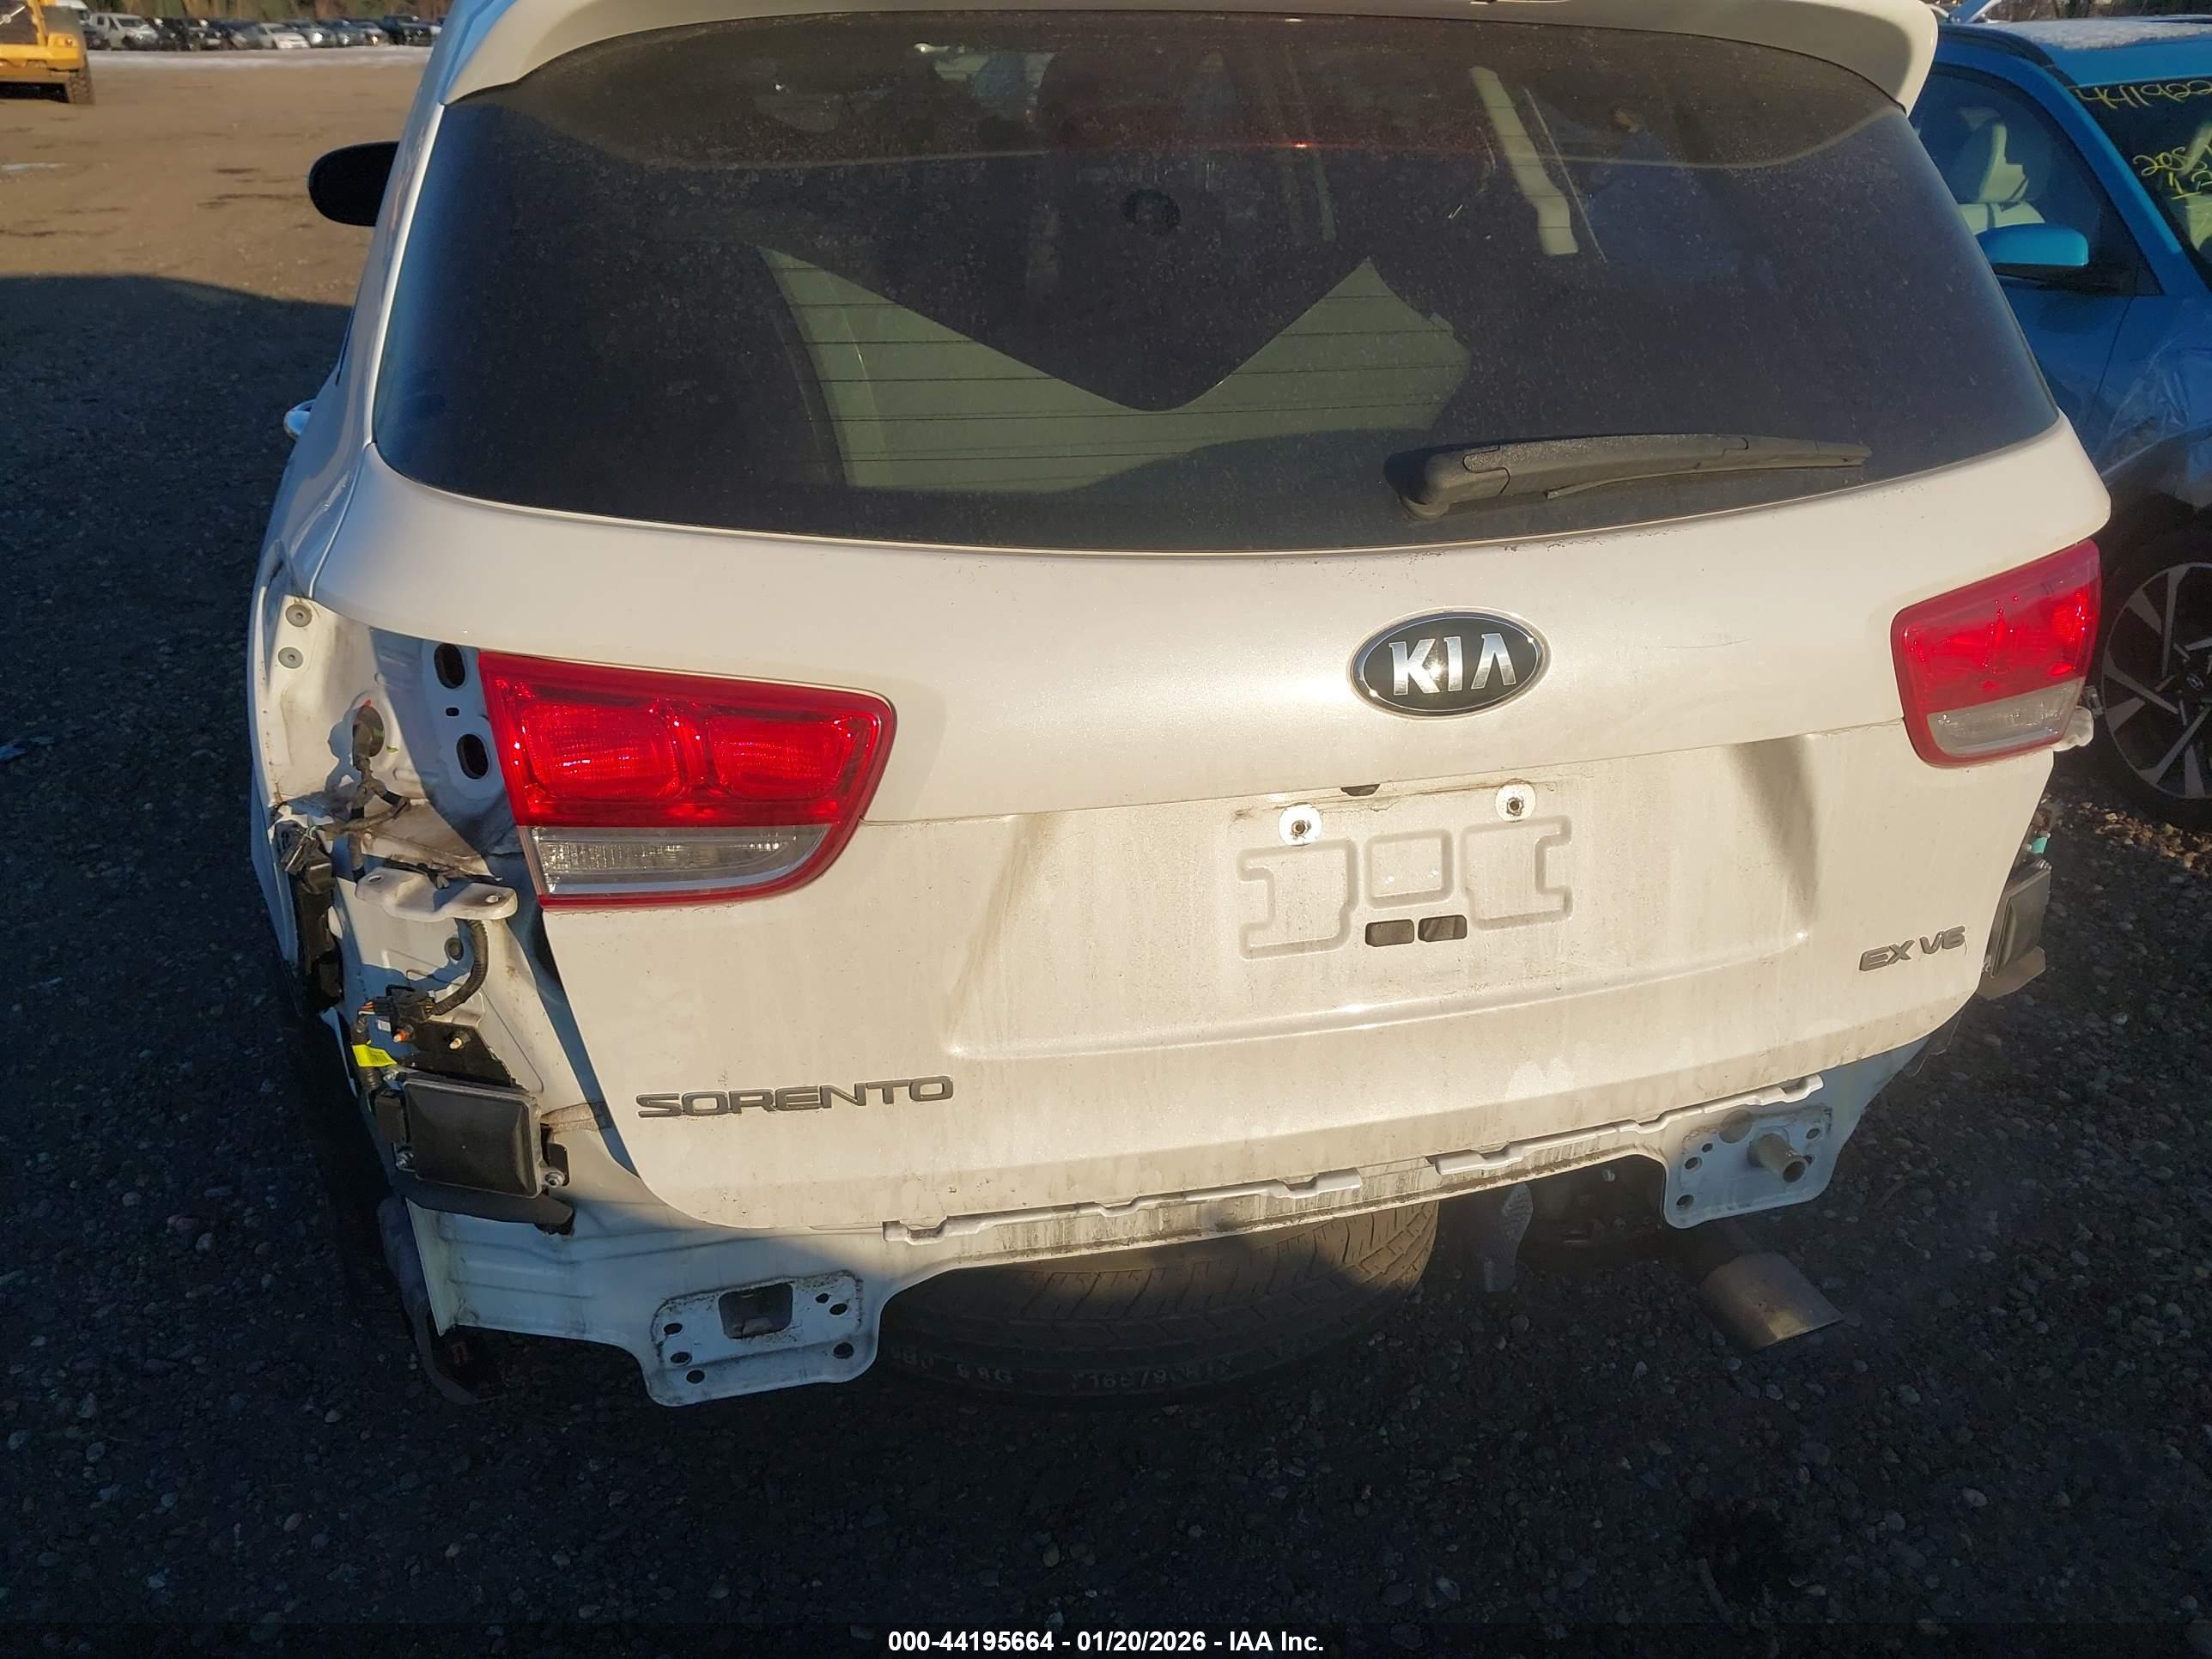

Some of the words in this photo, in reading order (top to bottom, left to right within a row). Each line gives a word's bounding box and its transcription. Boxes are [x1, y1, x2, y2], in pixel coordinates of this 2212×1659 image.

[1389, 633, 1516, 696] KIA
[1859, 939, 1915, 972] EX
[1919, 926, 1966, 955] V6
[636, 1075, 954, 1118] SORENTO
